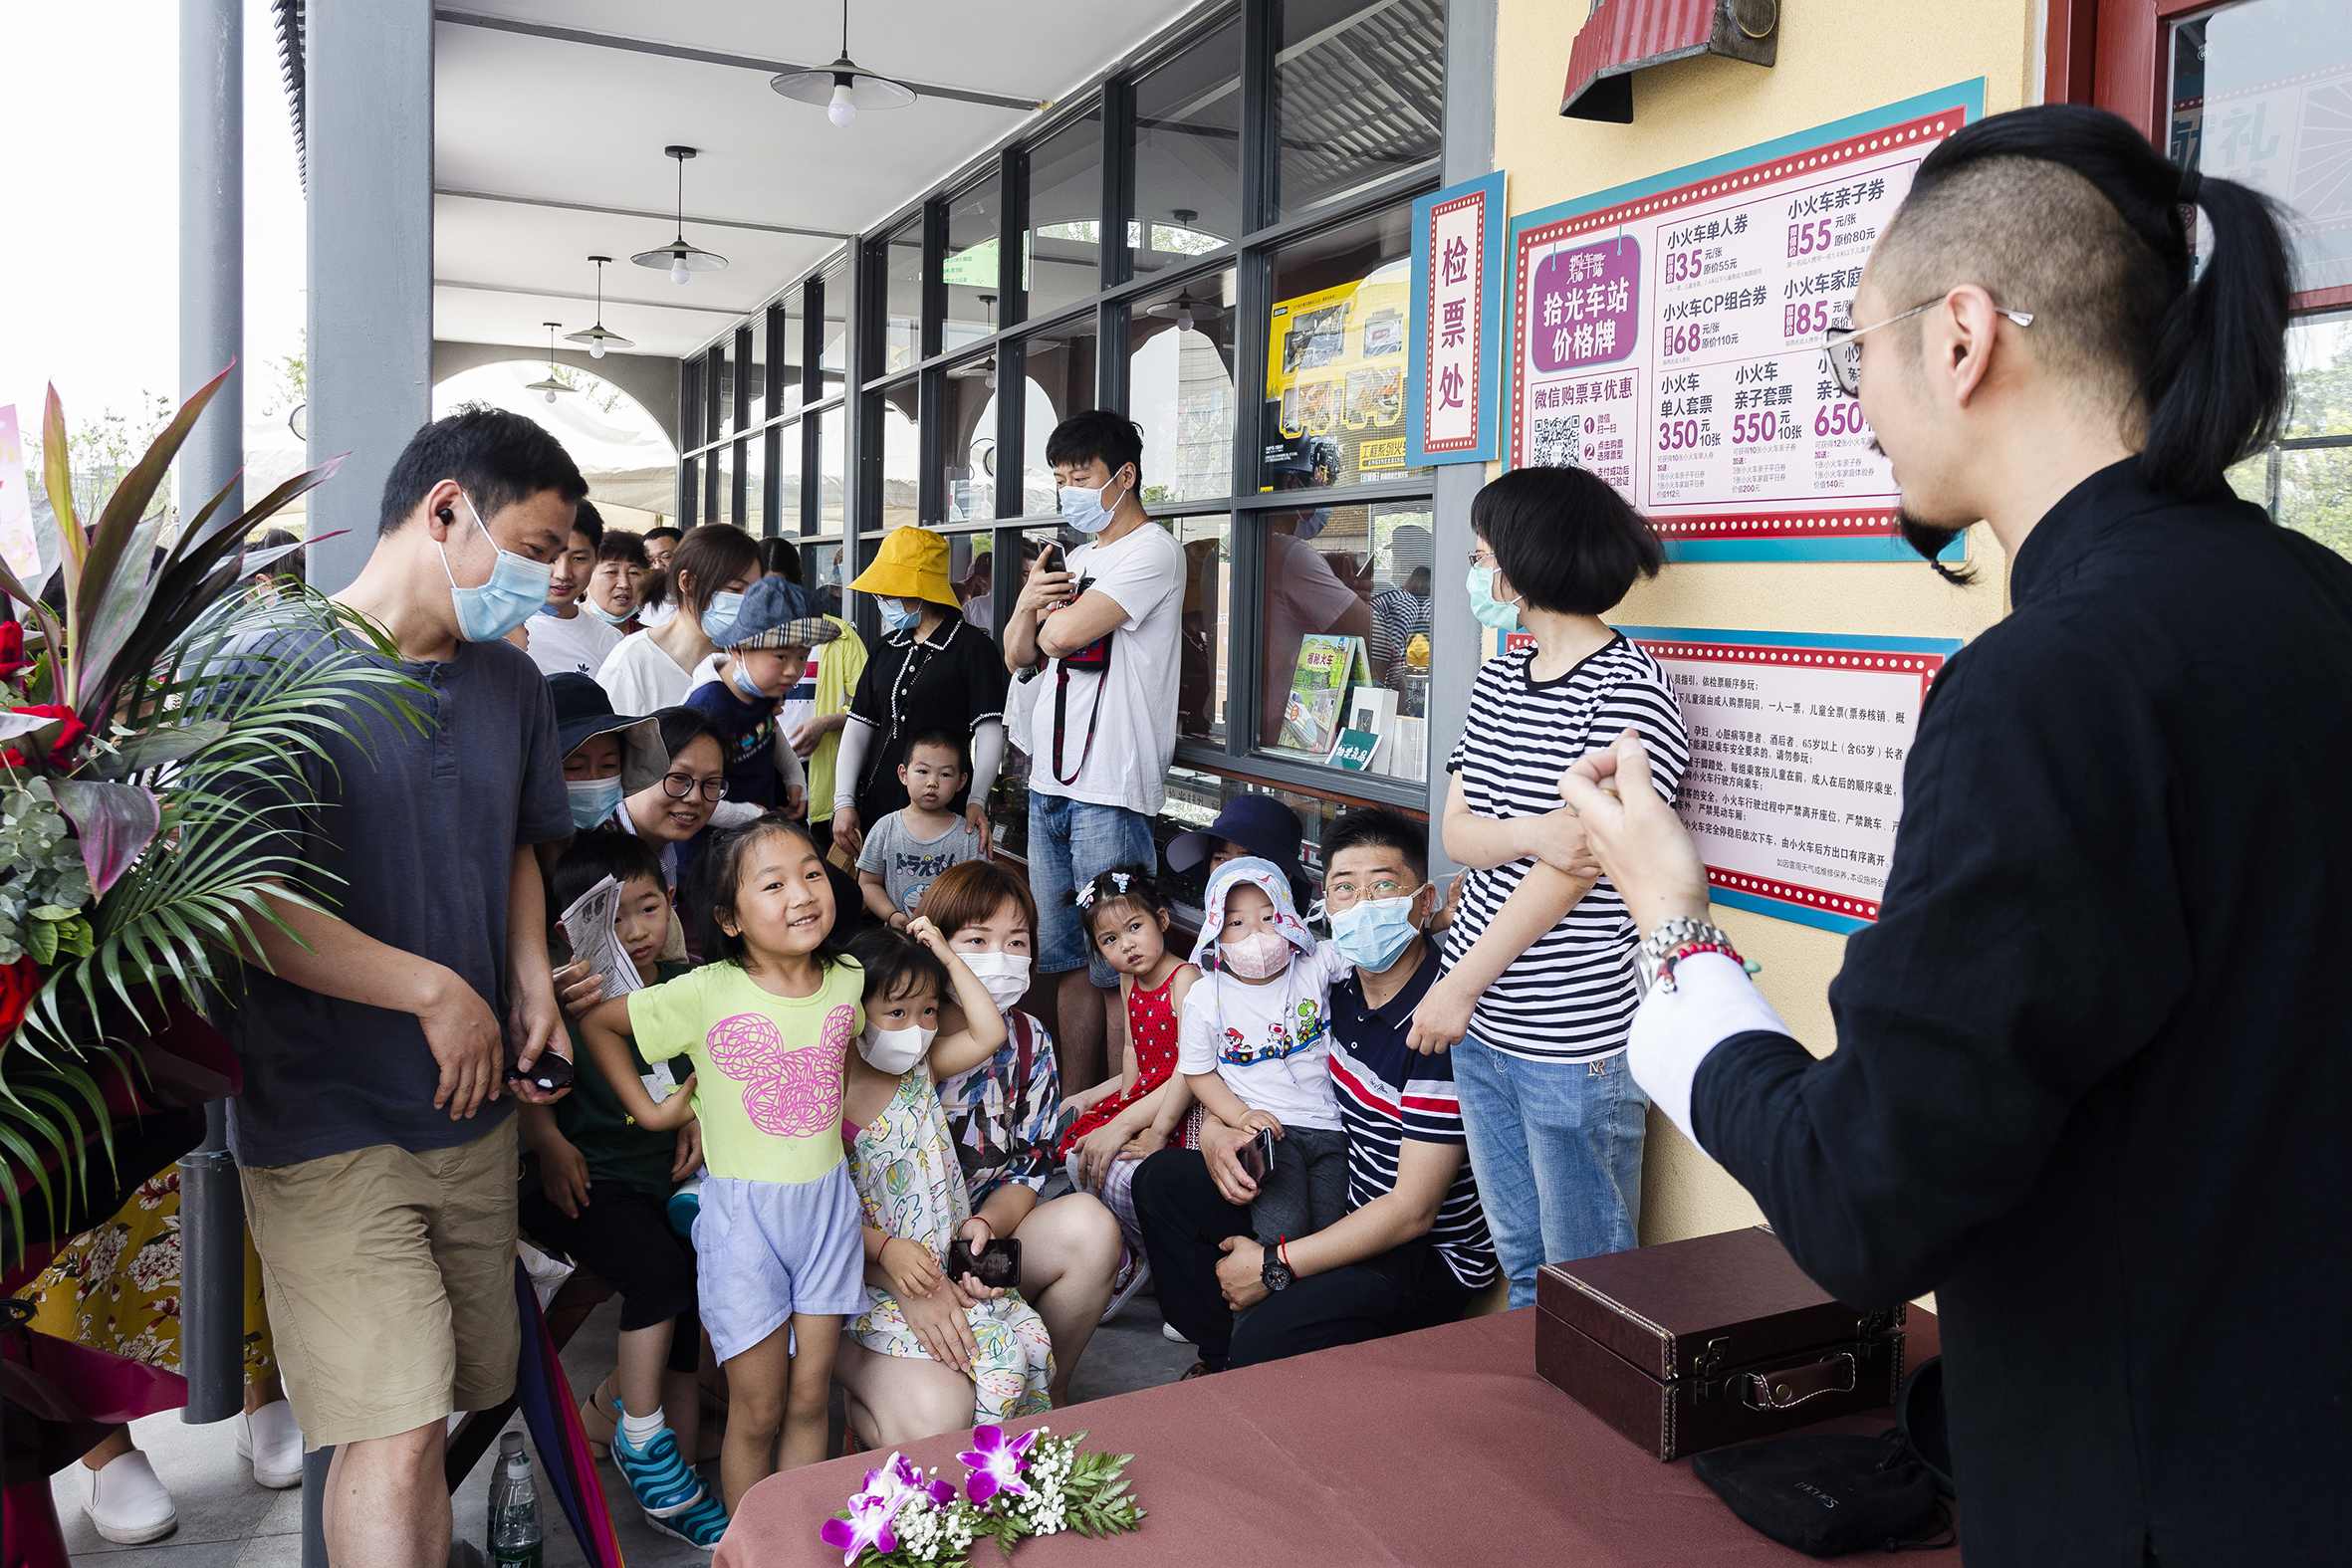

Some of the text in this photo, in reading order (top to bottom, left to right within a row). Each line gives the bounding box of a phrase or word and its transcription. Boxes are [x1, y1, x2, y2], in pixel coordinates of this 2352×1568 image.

[1787, 178, 1885, 220] 小火车亲子券
[1667, 213, 1749, 250] 小火车单人券
[1835, 213, 1857, 228] 元/张
[1799, 219, 1831, 255] 55
[1834, 227, 1875, 247] 原价80元
[1676, 249, 1702, 281] 35
[1704, 258, 1738, 275] 原价55元
[1705, 247, 1723, 260] 元/张
[1783, 266, 1863, 300] 小火车家庭
[1543, 276, 1630, 328] 拾光车站
[1663, 285, 1767, 322] 小火车CP组合券
[1439, 235, 1469, 411] 检票处
[1702, 323, 1720, 336] 元/张
[1796, 300, 1827, 335] 85
[1552, 319, 1616, 363] 价格牌
[1674, 324, 1701, 354] 68
[1702, 334, 1740, 349] 原价110元
[1661, 372, 1700, 394] 小火车
[1736, 361, 1778, 385] 小火车
[1534, 376, 1633, 411] 微信购票享优惠
[1661, 394, 1713, 418] 单人套票
[1735, 384, 1792, 410] 亲子套票
[1701, 419, 1710, 432] 元
[1733, 411, 1775, 444] 550
[1777, 425, 1802, 439] 10张
[1779, 410, 1790, 424] 元
[1814, 401, 1863, 436] 650
[1659, 419, 1698, 451] 350
[1700, 433, 1721, 447] 10张
[1683, 770, 1763, 791] 向小火车行驶方向乘车；
[1681, 818, 1889, 868] 小火车完全停稳后依次下车，由小火车后方出口有序离开。
